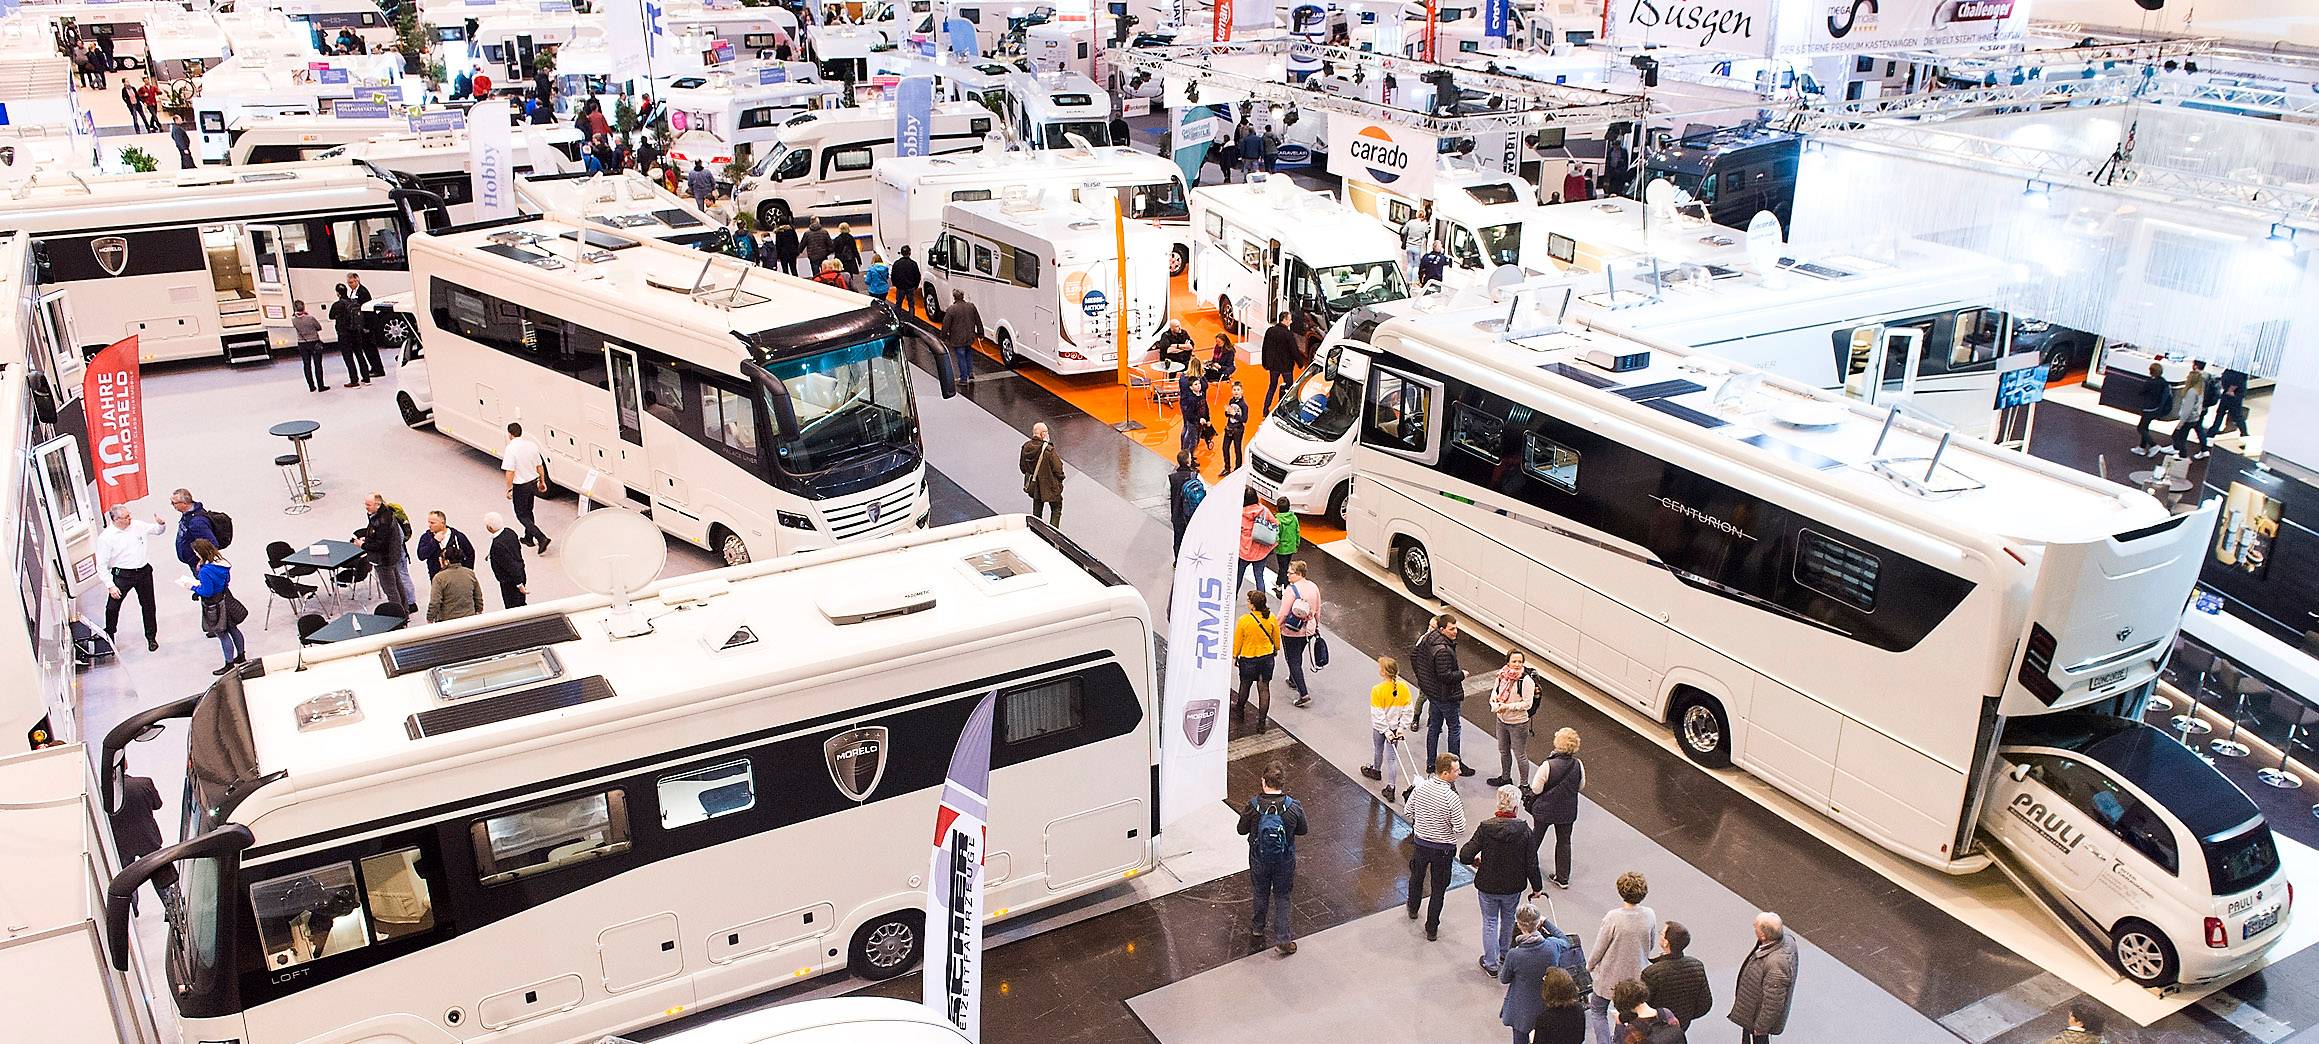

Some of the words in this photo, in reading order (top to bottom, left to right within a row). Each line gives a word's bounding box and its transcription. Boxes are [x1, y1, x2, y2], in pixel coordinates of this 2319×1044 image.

[1958, 2, 2013, 19] Challenger
[1831, 42, 1864, 52] PREMIUM
[1955, 34, 1976, 44] STEHT
[904, 113, 920, 157] obby
[1351, 140, 1408, 169] carado
[481, 143, 500, 208] Hobby
[98, 372, 117, 430] JAHRE
[116, 371, 134, 462] MORELO
[1661, 497, 1743, 539] CENTURION
[1195, 577, 1222, 663] RMS
[1187, 710, 1215, 720] MORELO
[837, 745, 878, 761] MORELO
[2013, 792, 2085, 849] PAULI
[2228, 895, 2253, 914] PAULI
[950, 831, 969, 1028] SCHER
[959, 836, 976, 1031] EIZEITFAHRZEUGE
[271, 967, 310, 985] LOFT
